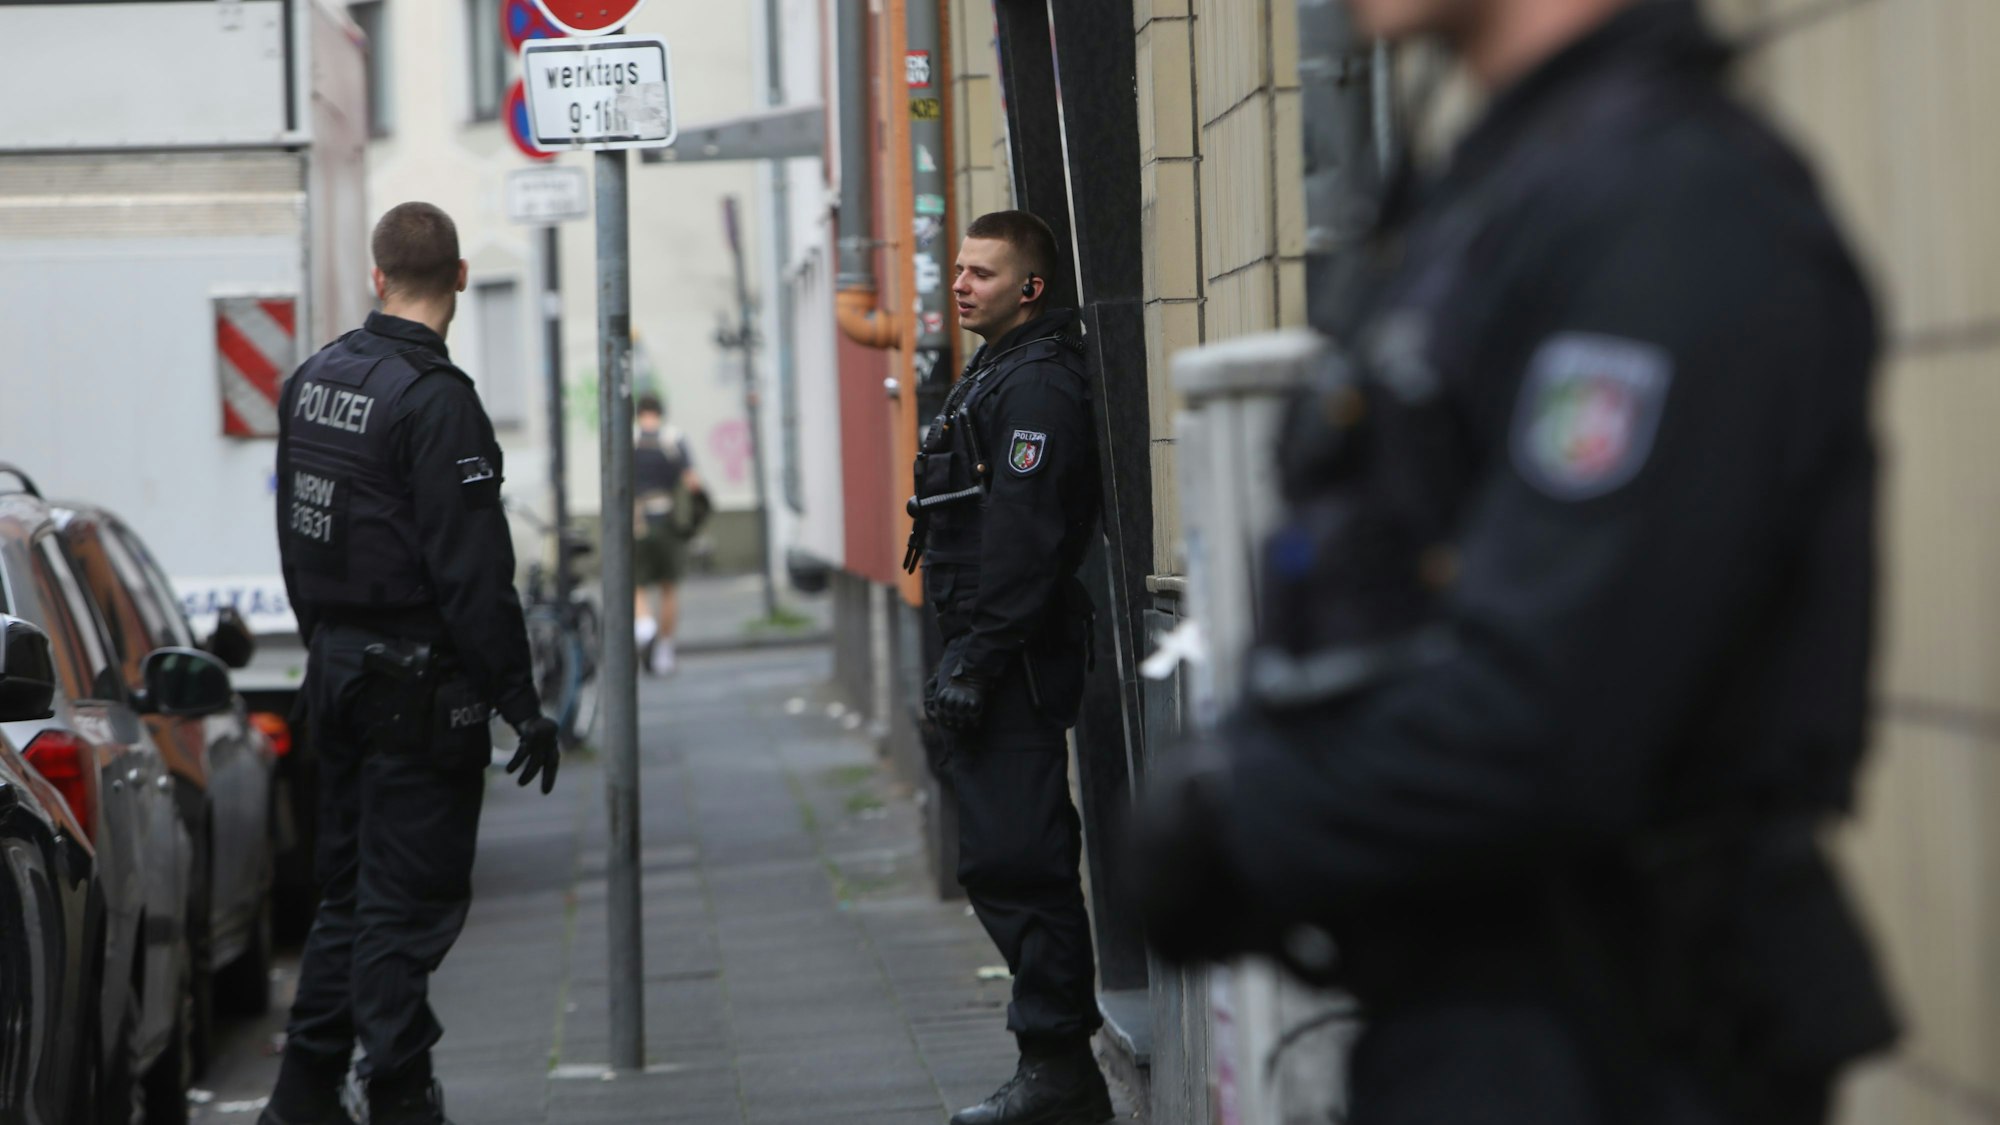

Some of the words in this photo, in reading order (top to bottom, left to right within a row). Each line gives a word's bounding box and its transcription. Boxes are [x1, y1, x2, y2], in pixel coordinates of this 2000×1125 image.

[546, 57, 639, 94] werktags
[294, 382, 375, 434] POLIZEI
[294, 470, 336, 507] NRW
[290, 501, 332, 542] 31531
